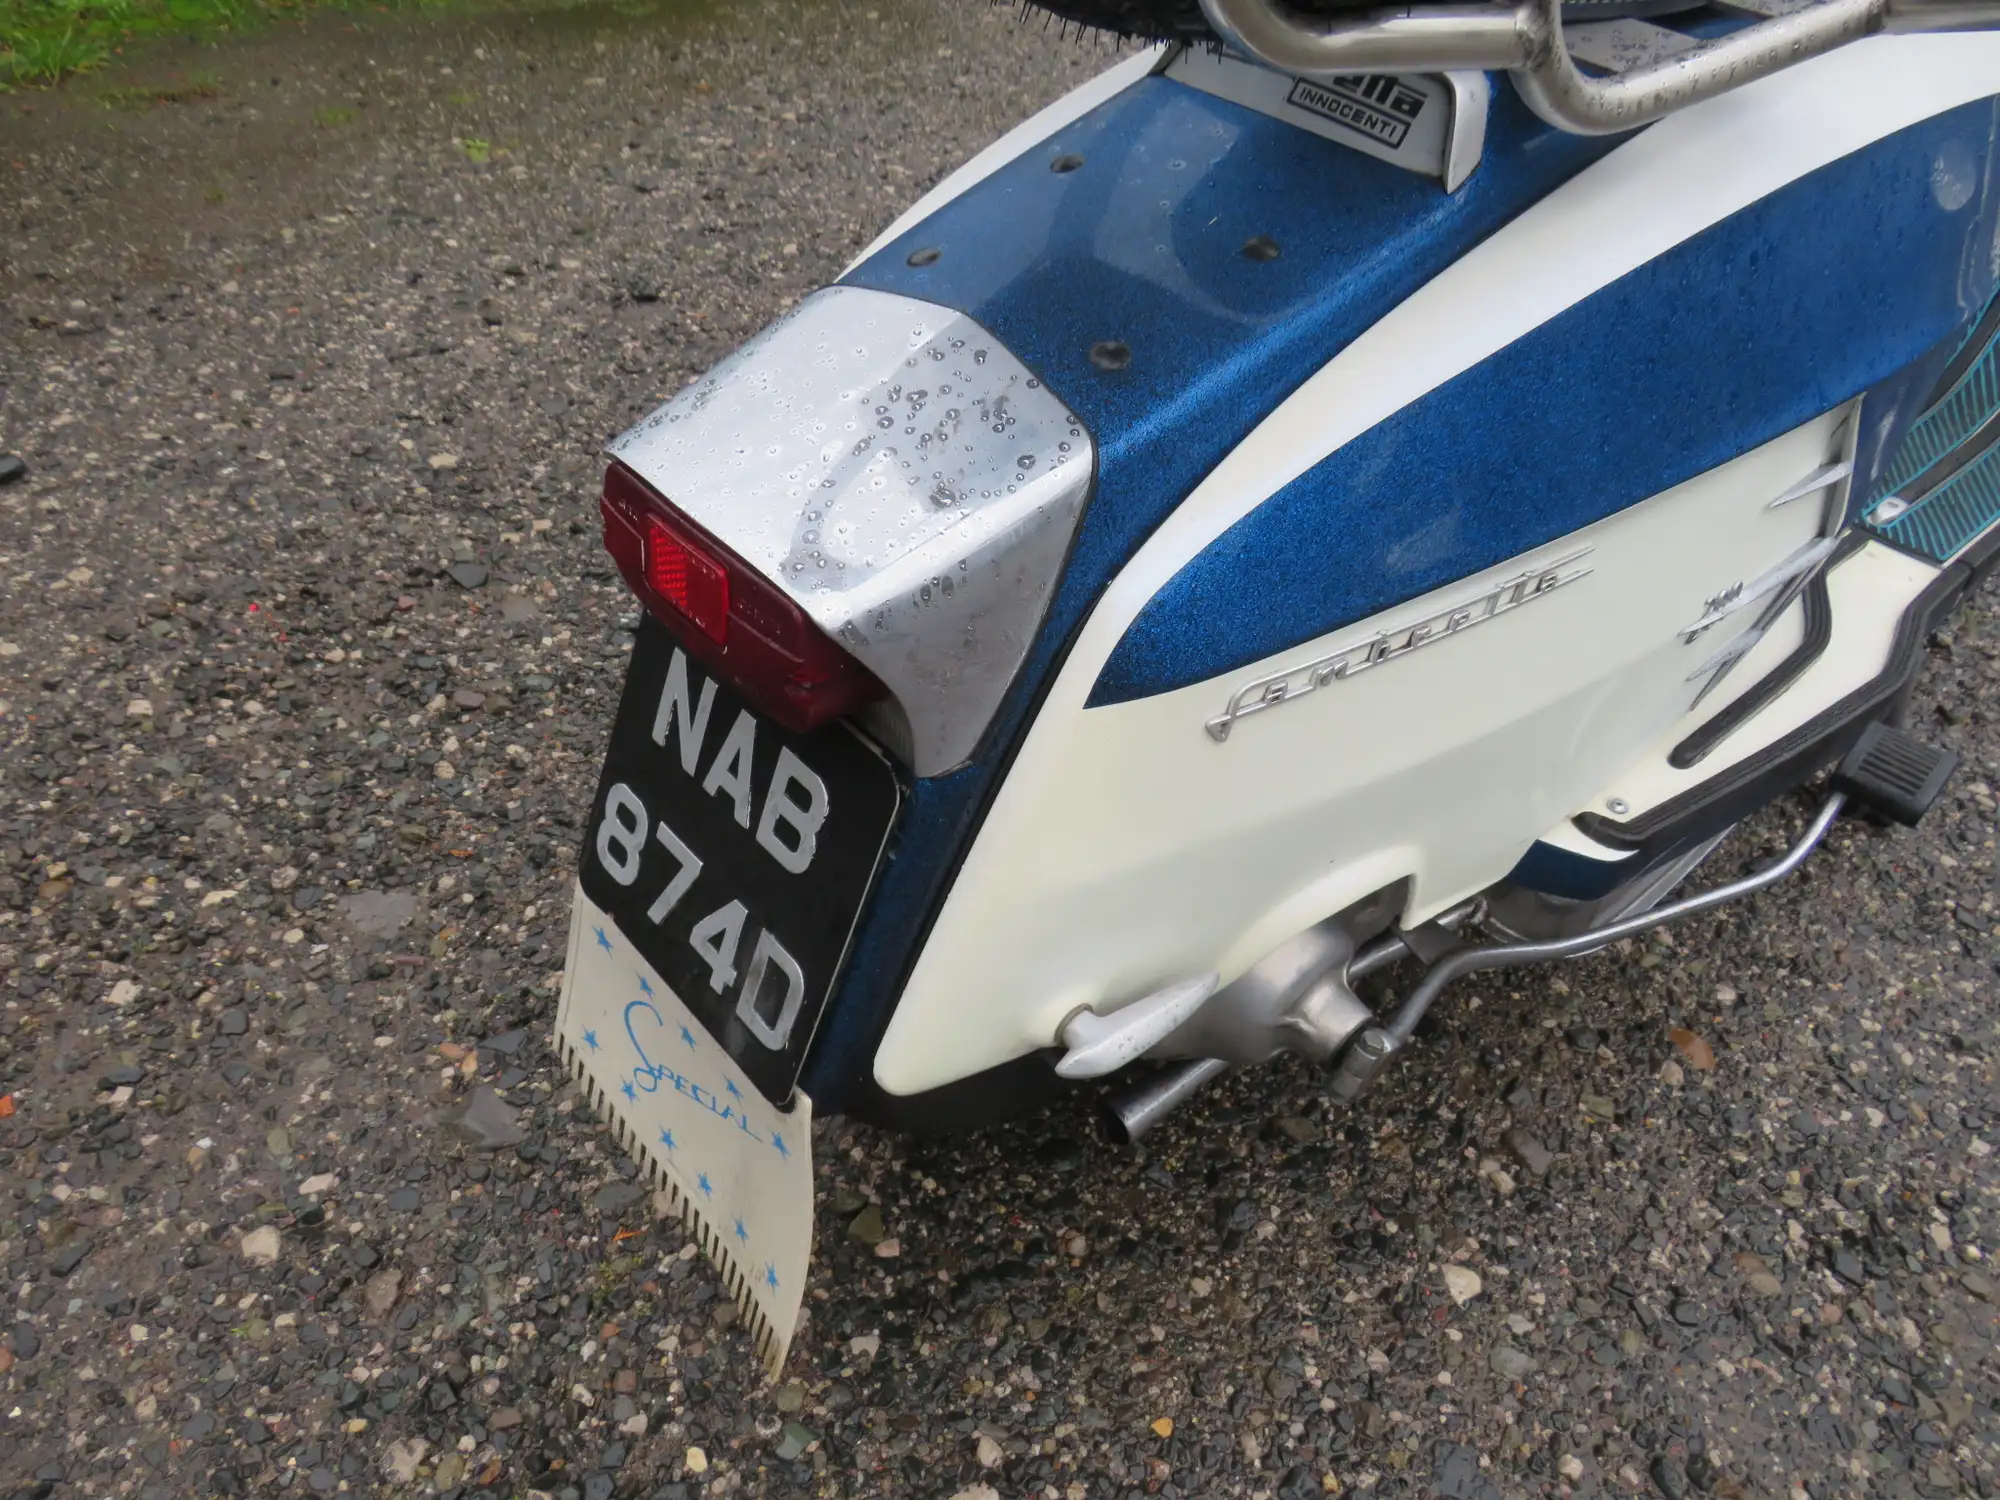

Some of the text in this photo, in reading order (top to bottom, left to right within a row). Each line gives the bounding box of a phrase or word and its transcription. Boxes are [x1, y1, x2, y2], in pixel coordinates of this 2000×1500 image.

[1299, 86, 1398, 139] INNOCENTI
[652, 647, 829, 874] NAB
[596, 782, 804, 1051] 874D
